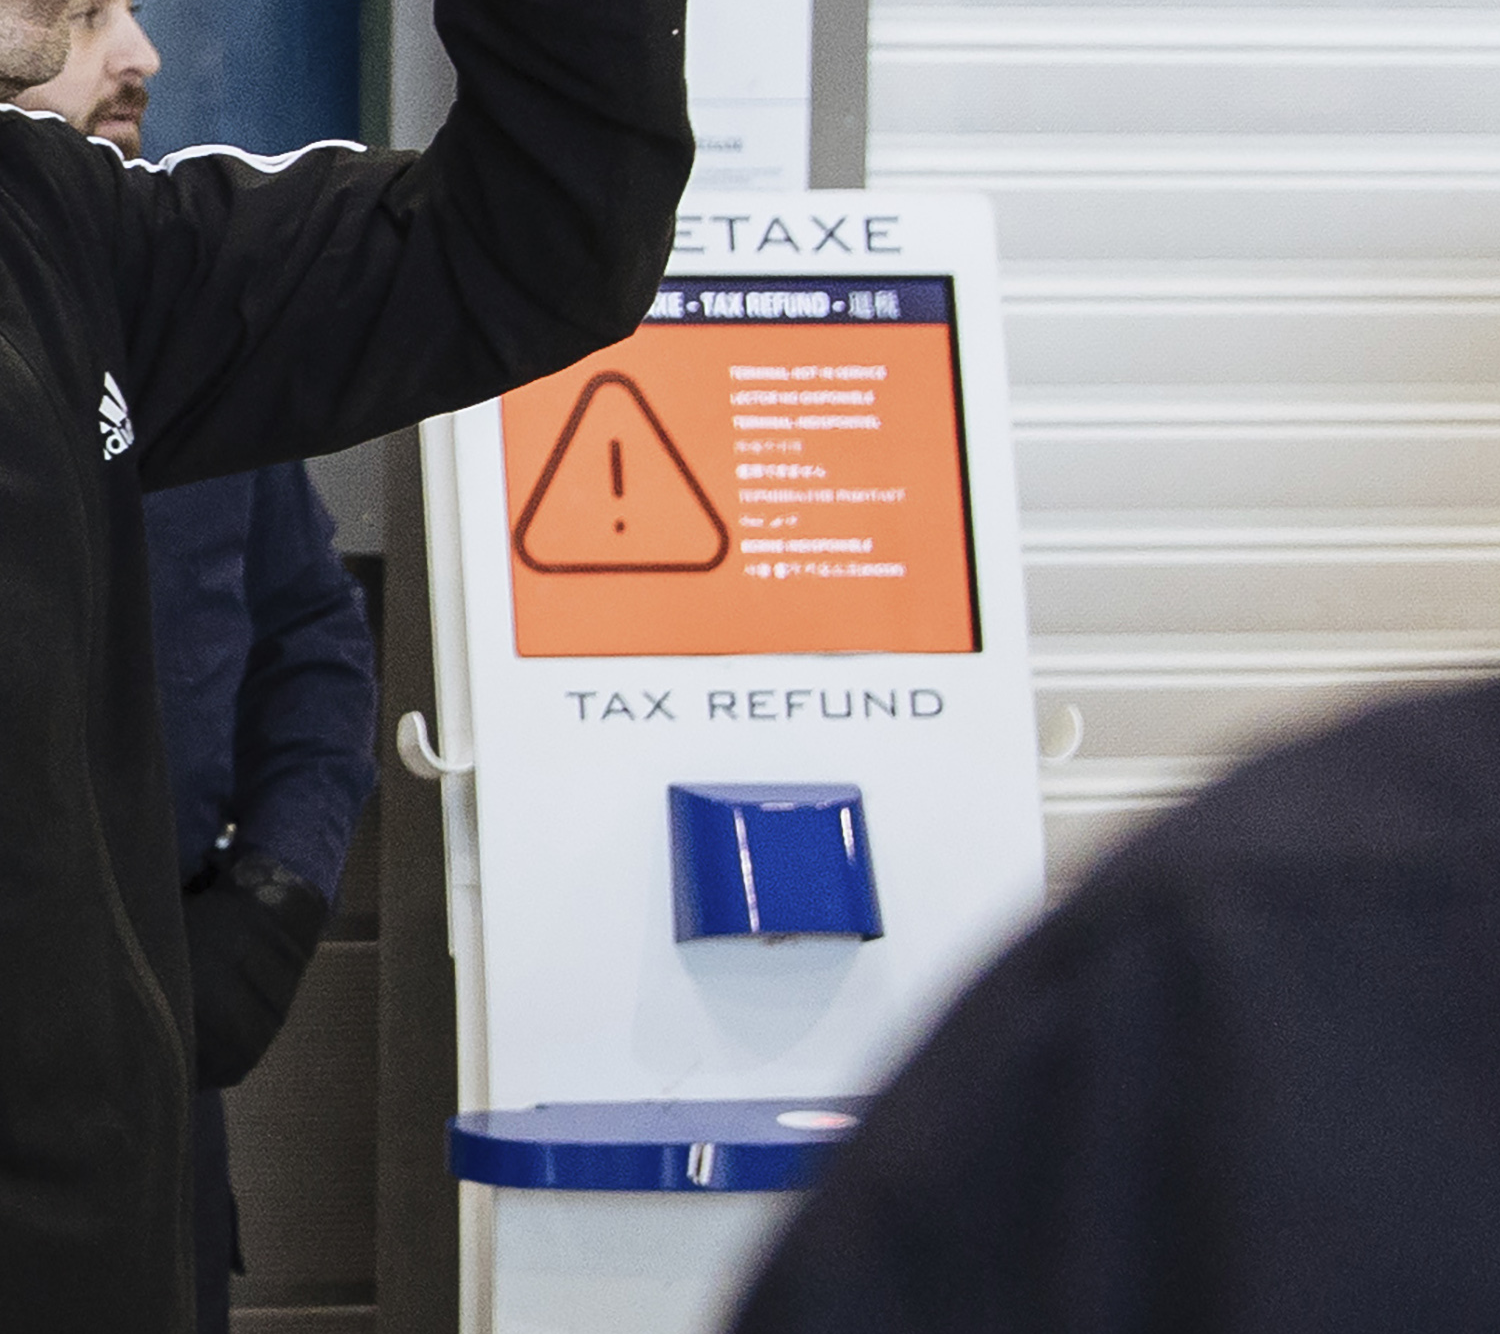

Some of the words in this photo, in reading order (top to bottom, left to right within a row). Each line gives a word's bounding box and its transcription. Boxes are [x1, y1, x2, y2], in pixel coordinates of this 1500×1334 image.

[672, 214, 902, 254] ETAXE
[700, 291, 745, 318] TAX
[746, 291, 830, 318] REFUND
[566, 689, 676, 721] TAX
[707, 688, 946, 721] REFUND
